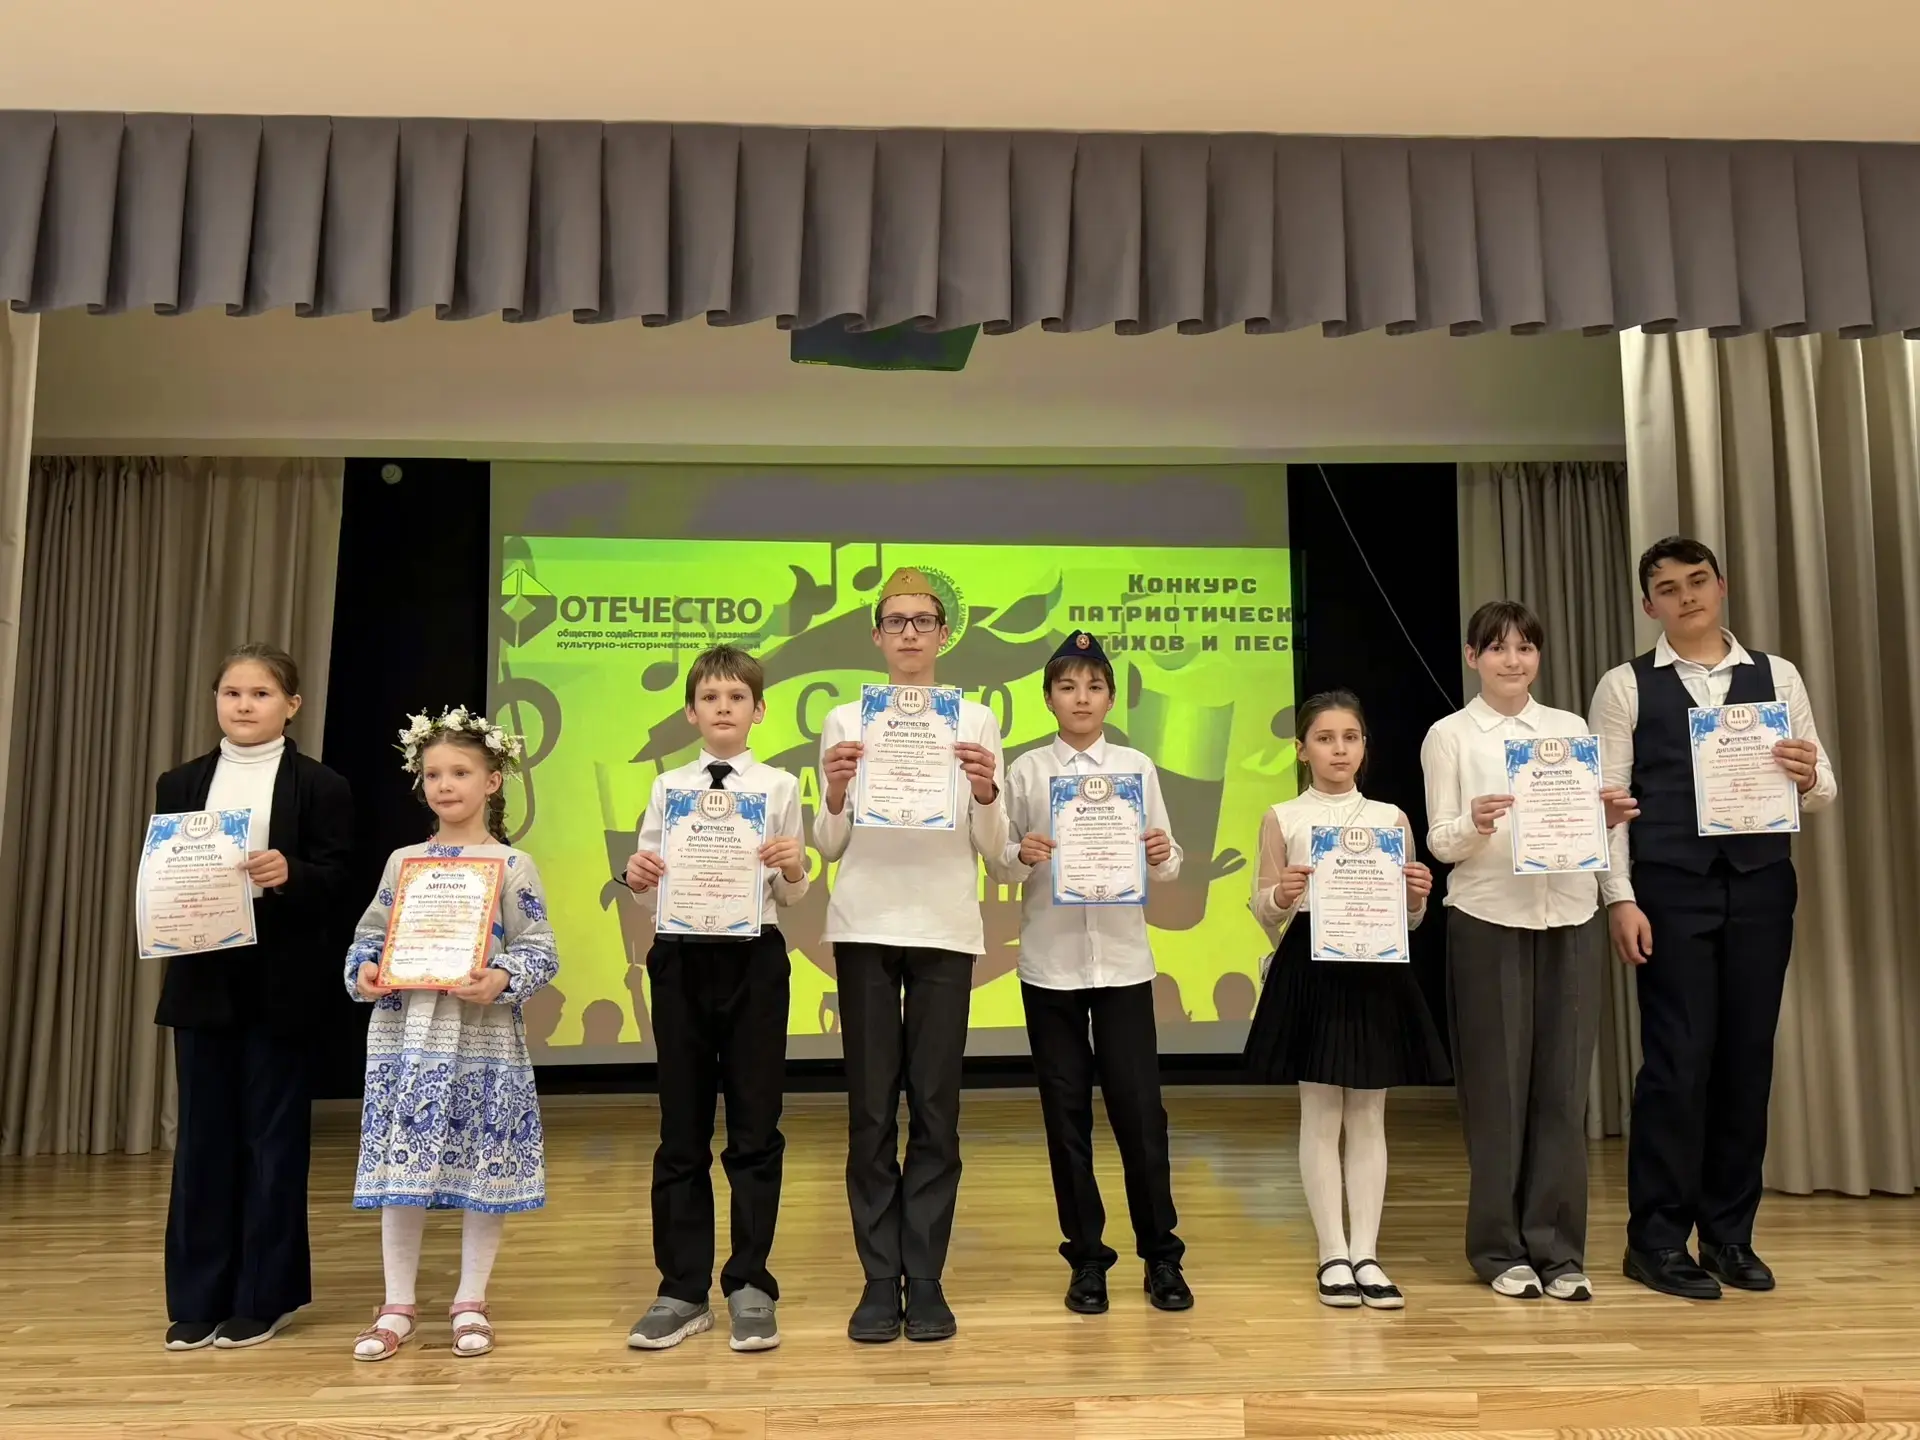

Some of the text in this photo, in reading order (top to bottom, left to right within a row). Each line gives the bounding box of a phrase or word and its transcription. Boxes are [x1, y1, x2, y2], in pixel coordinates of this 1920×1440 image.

[560, 596, 762, 624] ОТЕЧЕСТВО
[557, 630, 603, 639] общество
[605, 630, 658, 639] содействия
[556, 641, 700, 650] культурно-исторических
[1094, 636, 1184, 650] ТИХОВ
[905, 692, 917, 702] III
[1732, 710, 1745, 718] III
[1545, 742, 1557, 751] III
[710, 796, 722, 805] III
[194, 816, 207, 826] III
[1350, 832, 1363, 840] III
